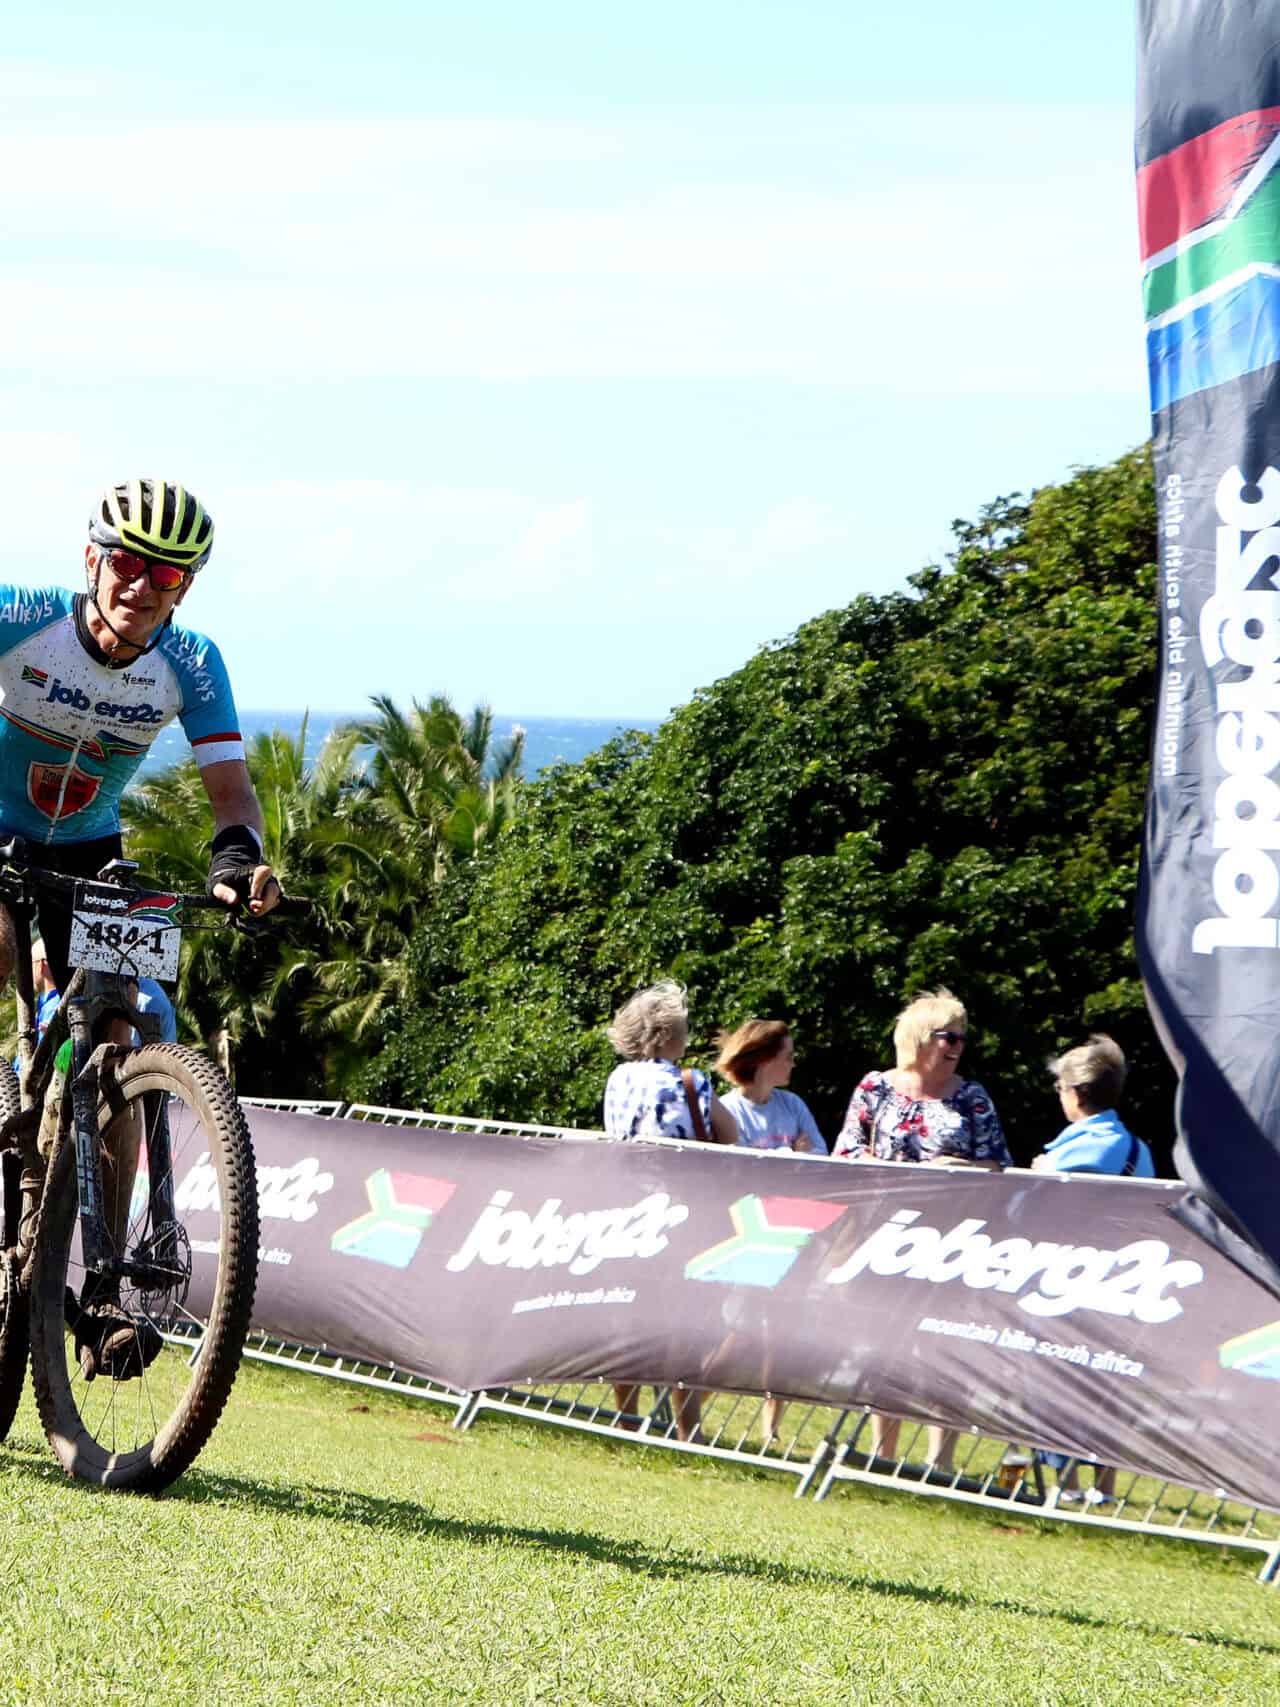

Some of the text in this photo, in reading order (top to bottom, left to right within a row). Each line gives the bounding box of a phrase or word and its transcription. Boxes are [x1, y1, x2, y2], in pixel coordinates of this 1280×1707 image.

[445, 1189, 689, 1276] joberg2c
[825, 1209, 1204, 1324] joberg2c
[917, 1317, 1145, 1378] mountain bike south africa
